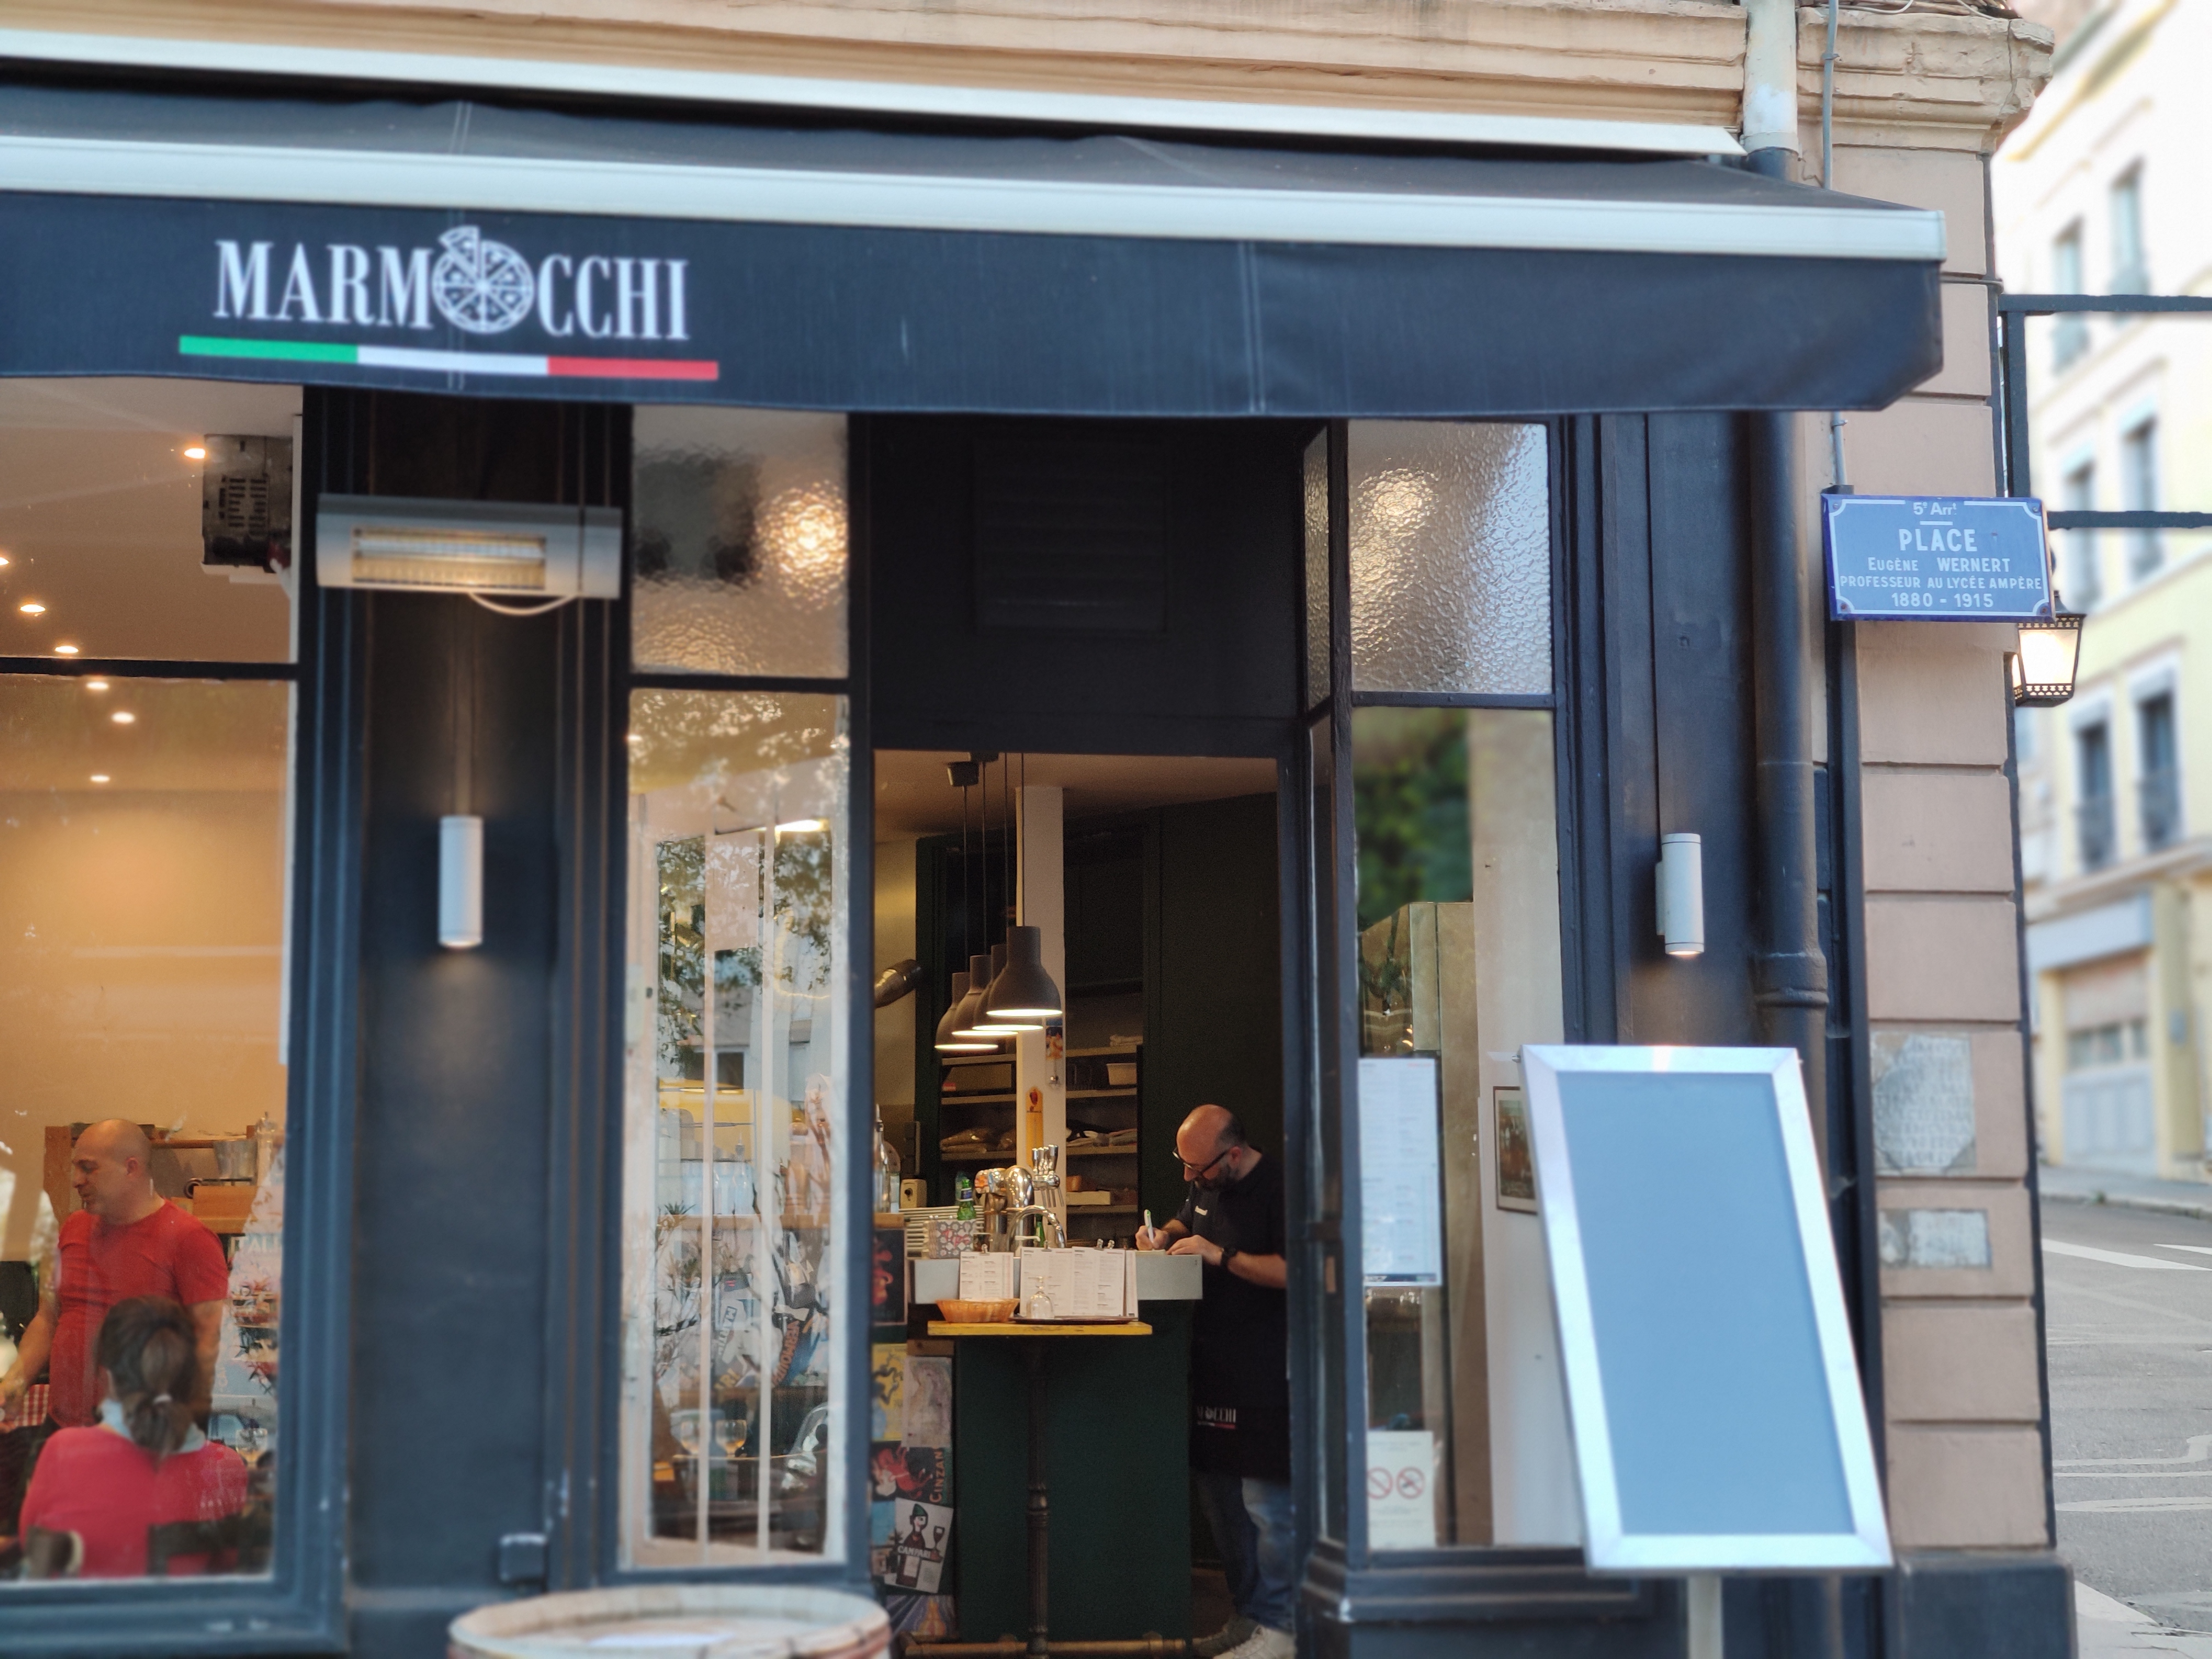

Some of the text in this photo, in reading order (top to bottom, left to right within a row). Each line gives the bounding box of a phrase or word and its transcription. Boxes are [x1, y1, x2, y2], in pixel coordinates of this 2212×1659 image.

[213, 225, 690, 340] MARMOCCHI
[1898, 528, 1978, 552] PLACE
[1936, 557, 2011, 573] WERNERT
[1839, 574, 2042, 590] PROFESSEUR AU LYCÉE AMPÈRE
[1891, 592, 1933, 607] 1880
[1953, 593, 1994, 608] 1915
[929, 1447, 946, 1503] CINZAN
[897, 1544, 931, 1560] CAMPARI
